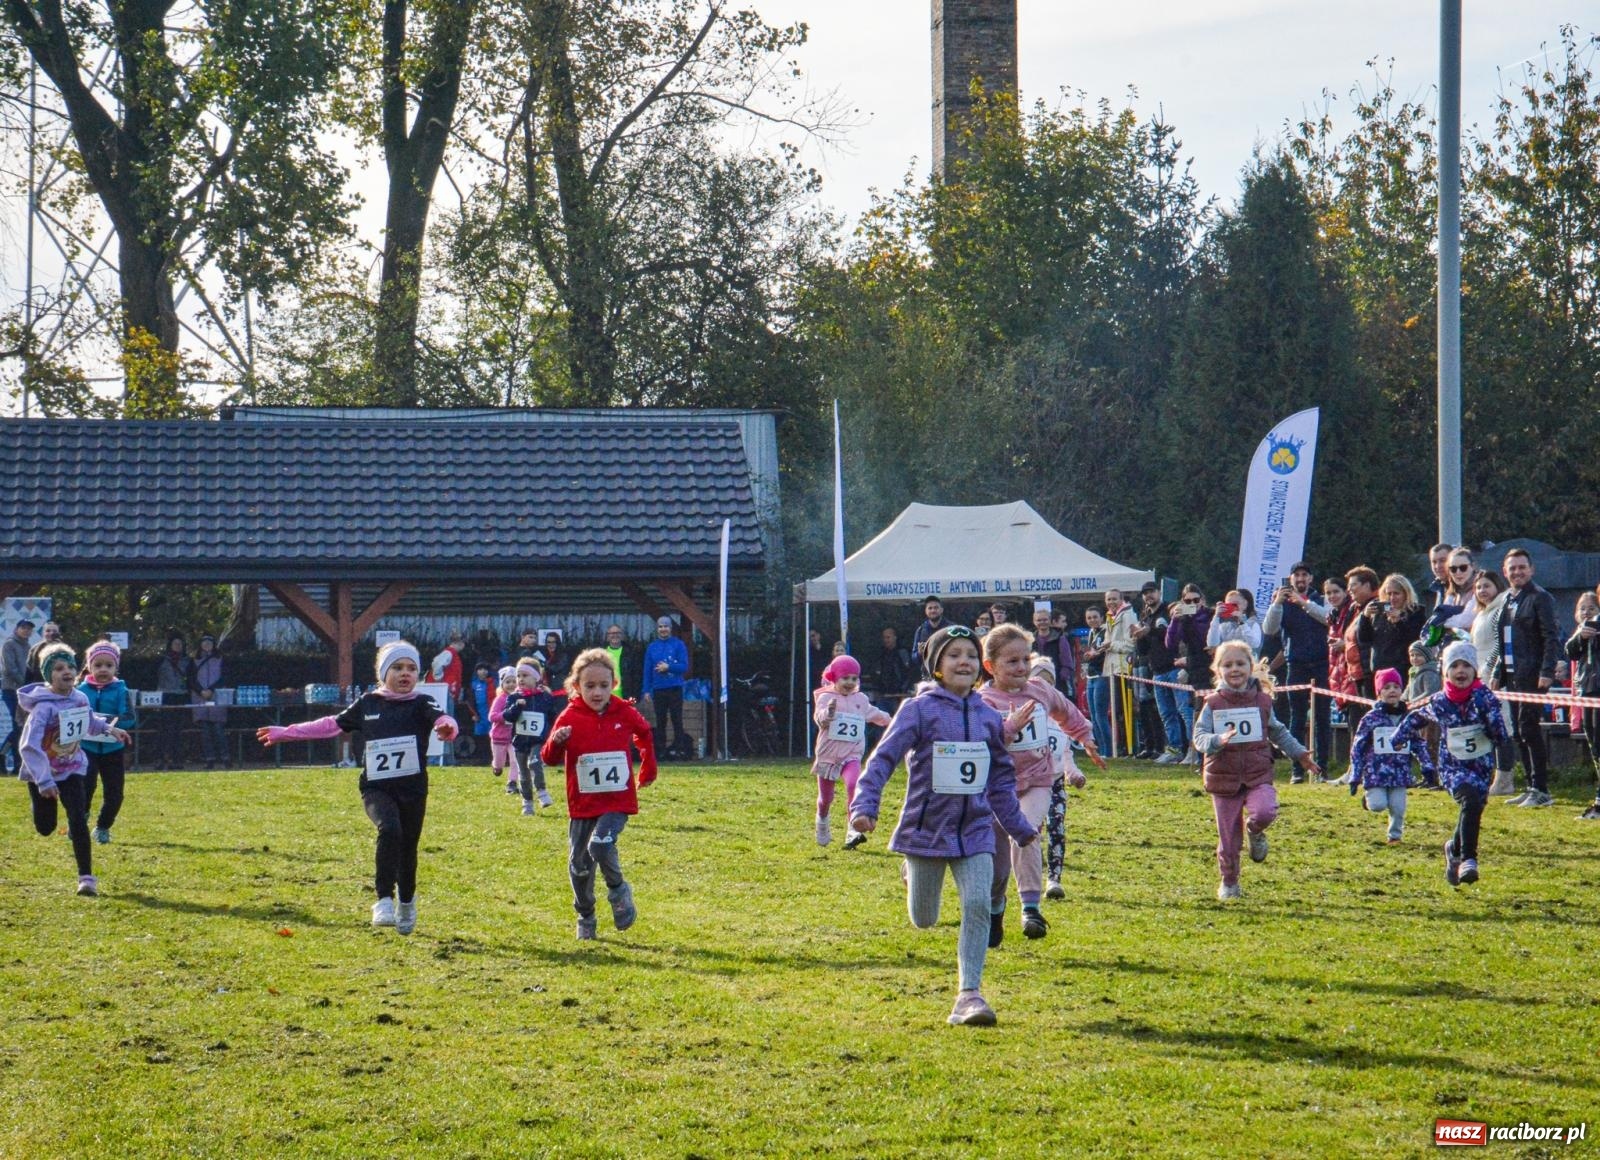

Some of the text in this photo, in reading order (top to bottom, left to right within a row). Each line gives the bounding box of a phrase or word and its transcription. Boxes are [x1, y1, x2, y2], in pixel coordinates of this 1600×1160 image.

[1265, 480, 1289, 533] STOWARZYSZENIE
[1262, 534, 1281, 562] AKTYWNI
[1259, 563, 1277, 576] DLA
[866, 577, 1097, 596] STOWARZYSZENIE AKTYWNI DLA LEPSZEGO JUTRA
[66, 719, 83, 737] 31
[520, 719, 538, 731] 15
[837, 722, 858, 737] 23
[1465, 738, 1477, 753] 5
[375, 751, 406, 772] 27
[589, 766, 620, 785] 14
[960, 761, 977, 784] 9
